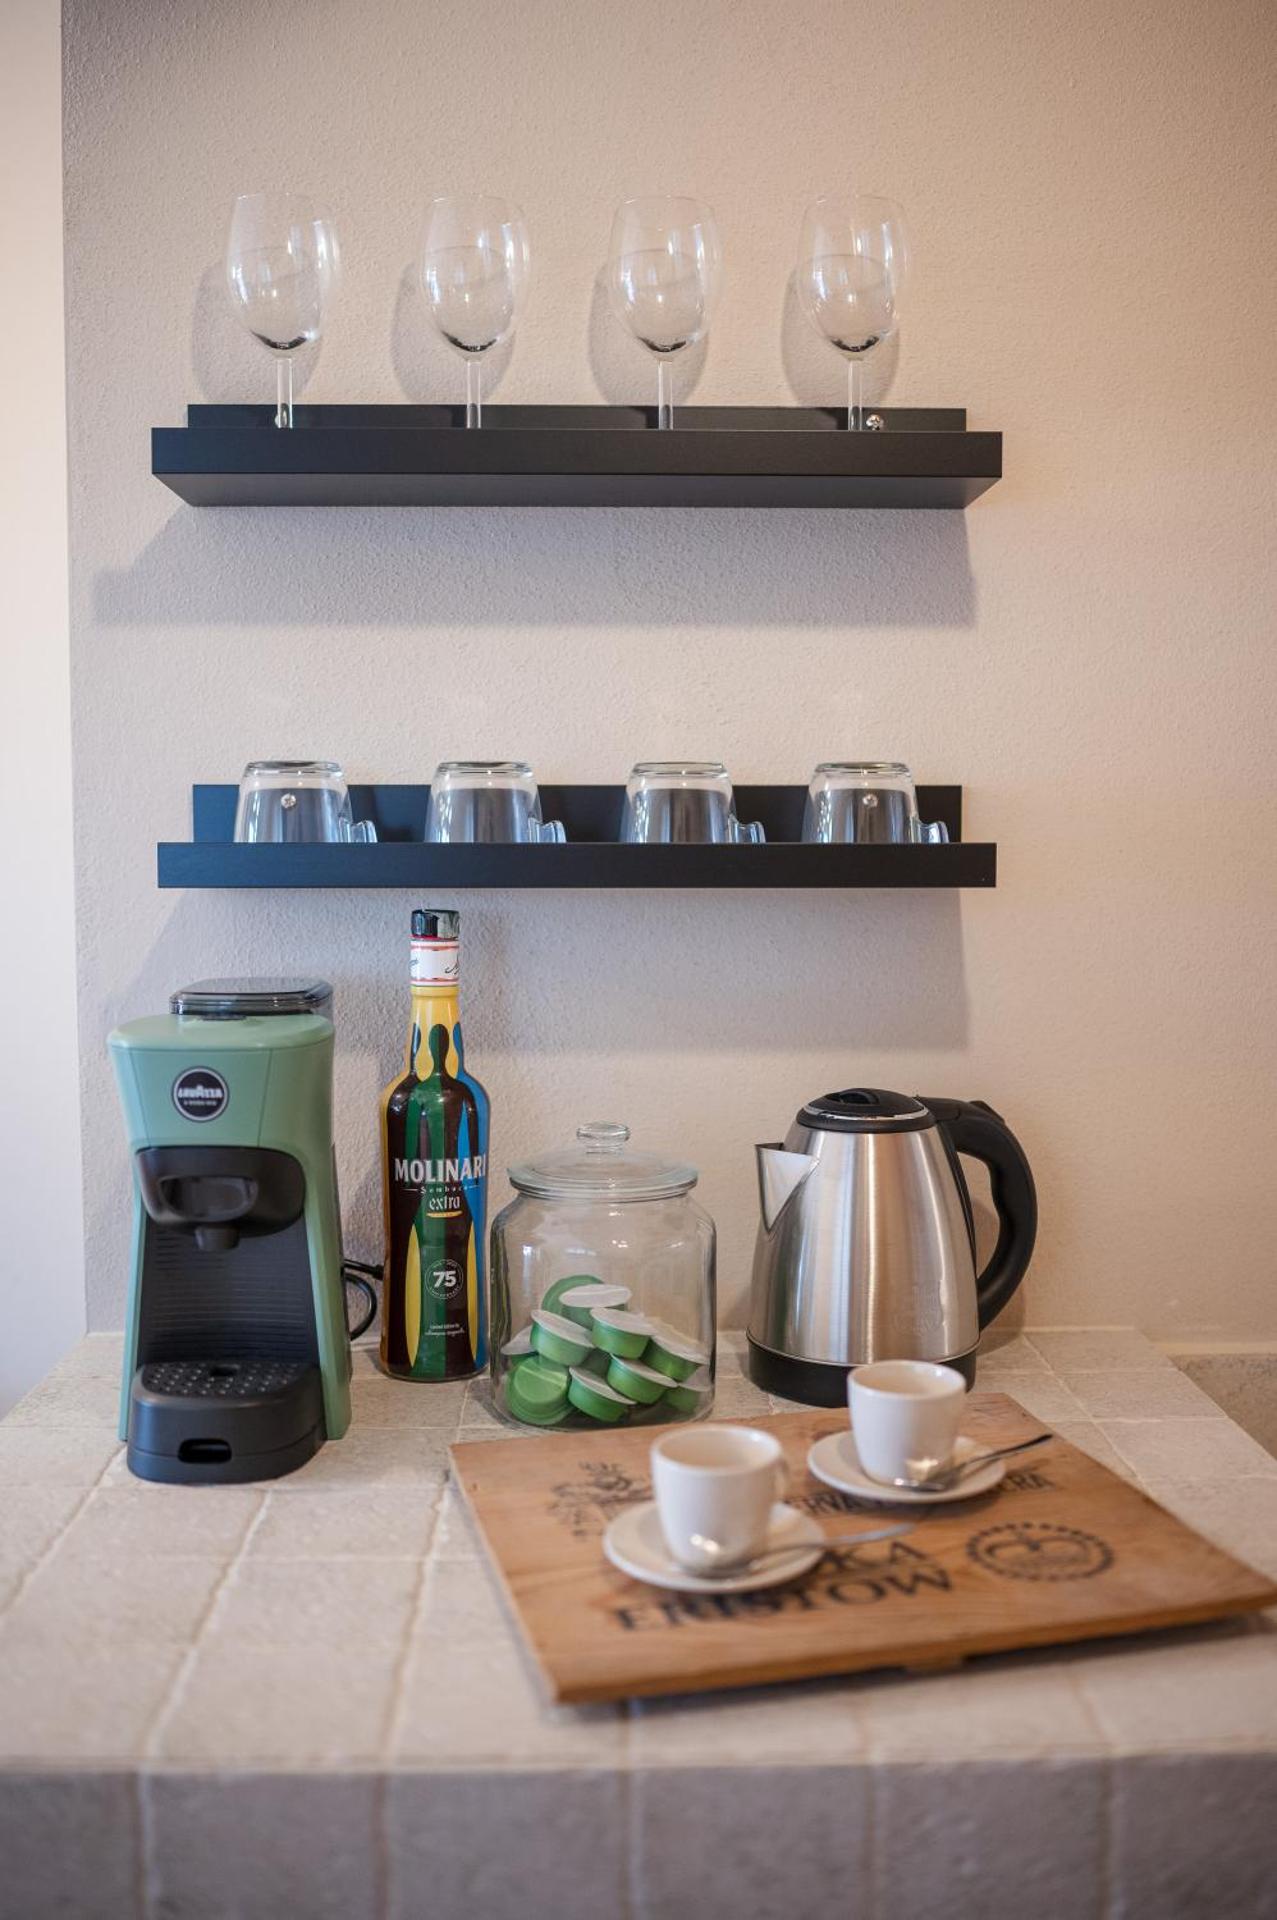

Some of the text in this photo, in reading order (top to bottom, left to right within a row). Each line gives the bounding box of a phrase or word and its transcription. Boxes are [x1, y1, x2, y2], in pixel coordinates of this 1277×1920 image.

[394, 1154, 486, 1183] MOLINARI
[429, 1196, 461, 1211] extra
[432, 1270, 457, 1288] 75
